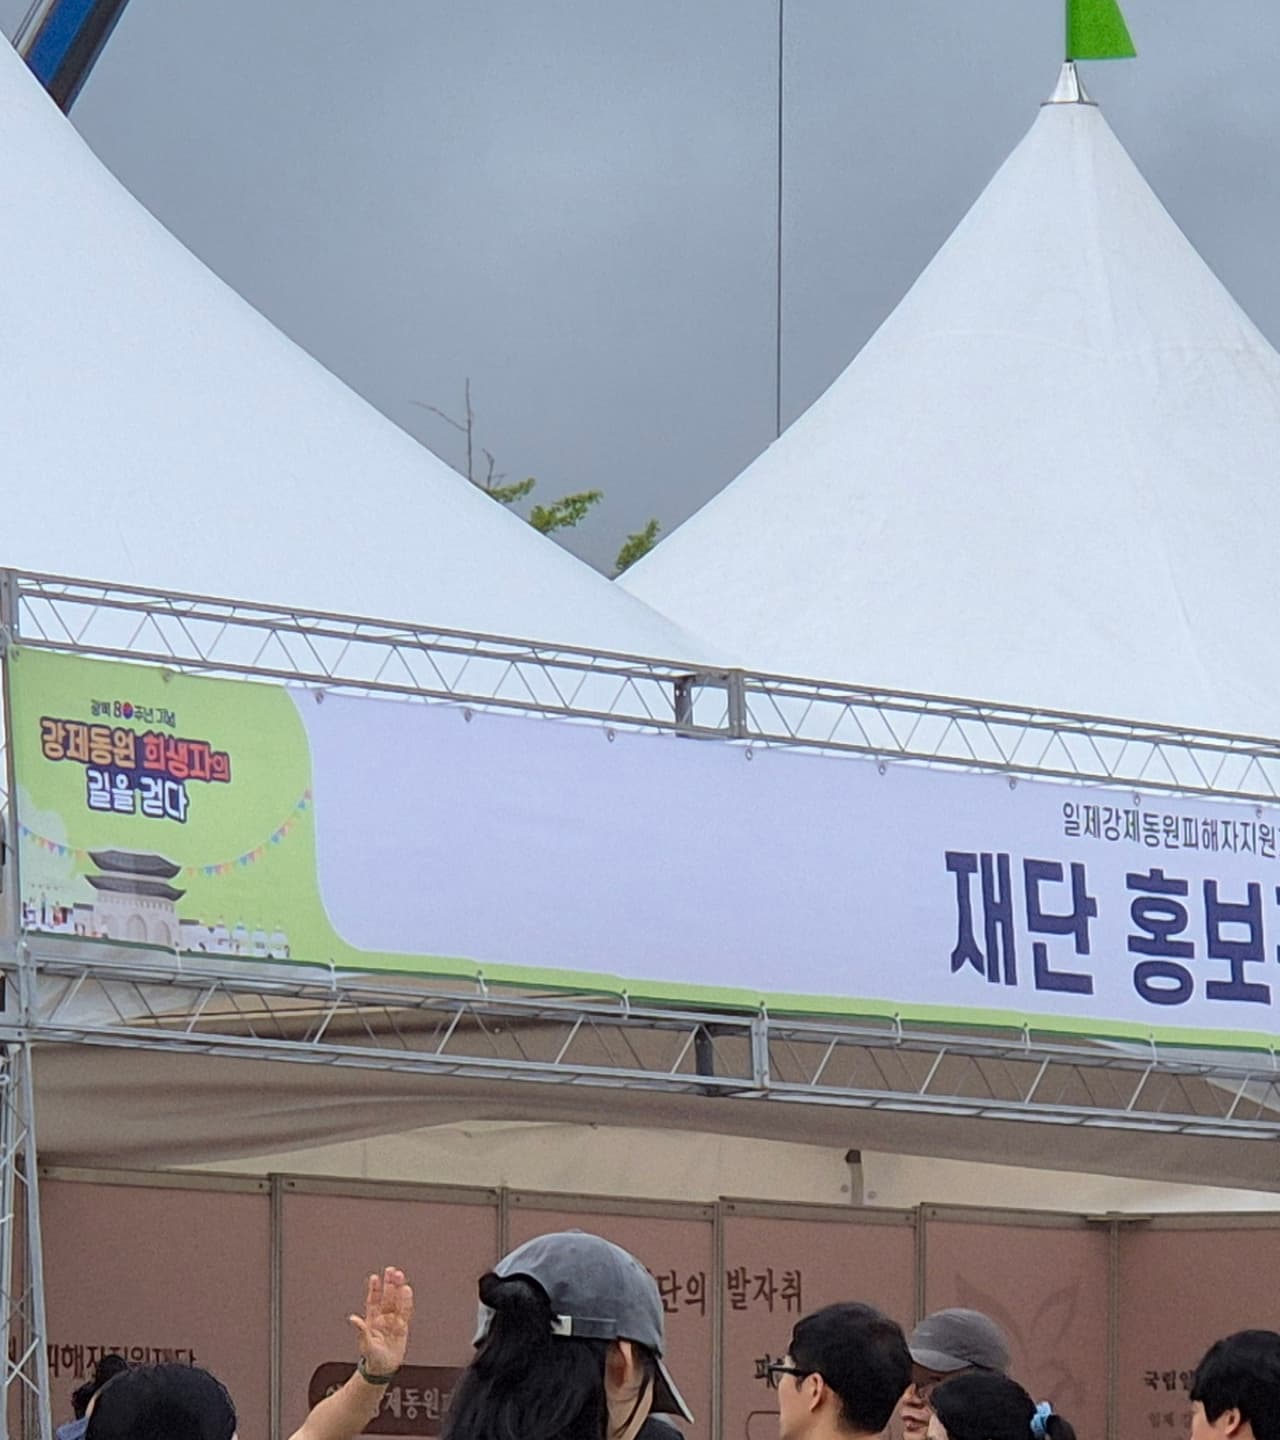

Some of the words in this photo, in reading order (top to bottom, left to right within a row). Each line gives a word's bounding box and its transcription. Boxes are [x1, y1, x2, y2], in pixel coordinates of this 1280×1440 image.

[40, 716, 136, 769] 강제동원
[141, 729, 231, 782] 희생자의
[86, 769, 136, 814] 길을
[139, 775, 189, 823] 걷다
[944, 850, 1098, 996] 재단
[725, 1266, 803, 1313] 발자취
